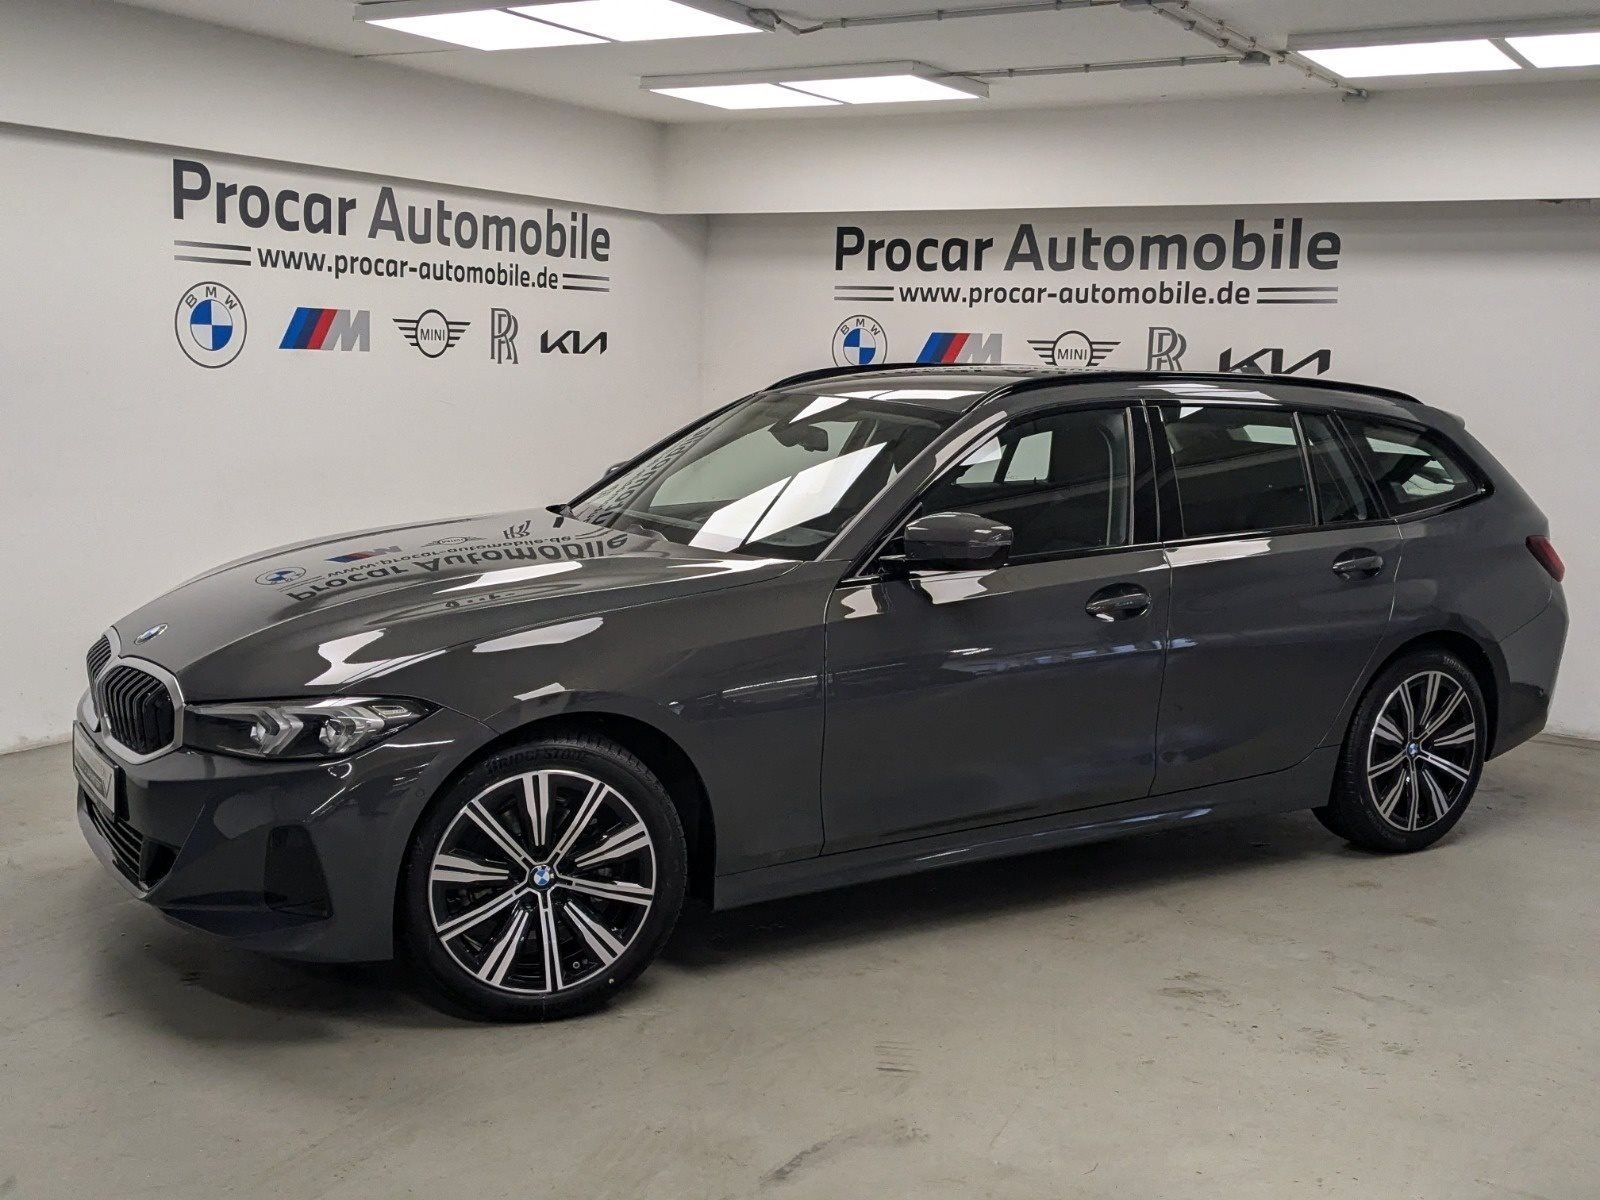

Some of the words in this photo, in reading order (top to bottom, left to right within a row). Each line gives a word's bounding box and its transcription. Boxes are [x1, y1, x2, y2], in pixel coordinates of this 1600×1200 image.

[172, 158, 356, 236] Procar
[367, 186, 611, 262] Automobile
[834, 226, 994, 272] Procar
[1003, 217, 1341, 272] Automobile
[257, 247, 559, 290] www.procar-automobile.de
[184, 286, 238, 310] BMW
[899, 280, 1250, 308] www.procar-automobile.de
[419, 328, 446, 342] MINI
[840, 318, 881, 336] BMW
[1057, 348, 1088, 361] MINI
